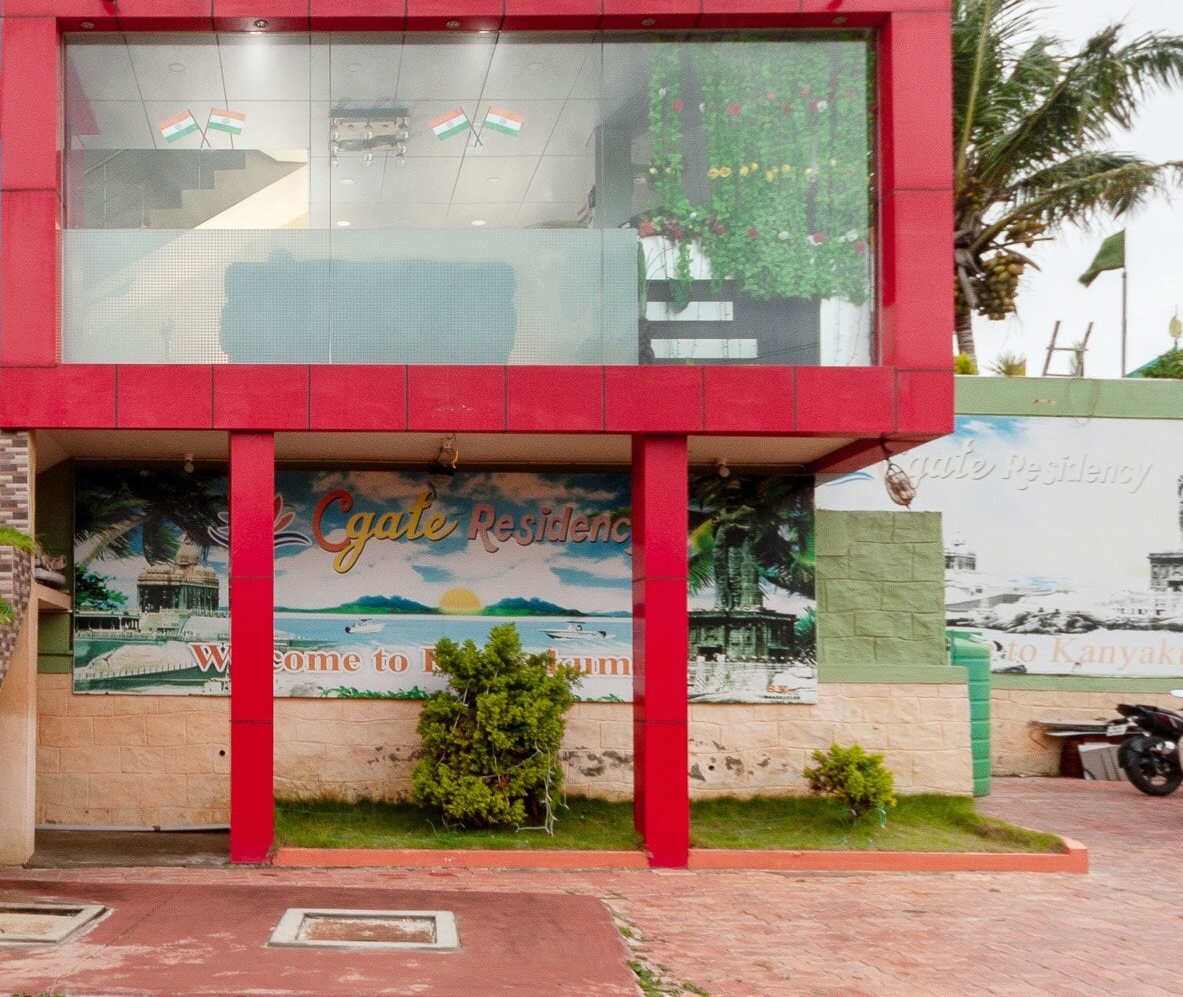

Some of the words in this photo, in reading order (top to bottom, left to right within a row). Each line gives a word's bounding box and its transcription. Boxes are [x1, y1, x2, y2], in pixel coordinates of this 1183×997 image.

[886, 438, 996, 492] gate
[1001, 453, 1154, 494] Residency
[312, 488, 459, 574] Cgate
[467, 503, 633, 556] Residenc
[373, 647, 409, 673] to
[1007, 638, 1038, 663] to
